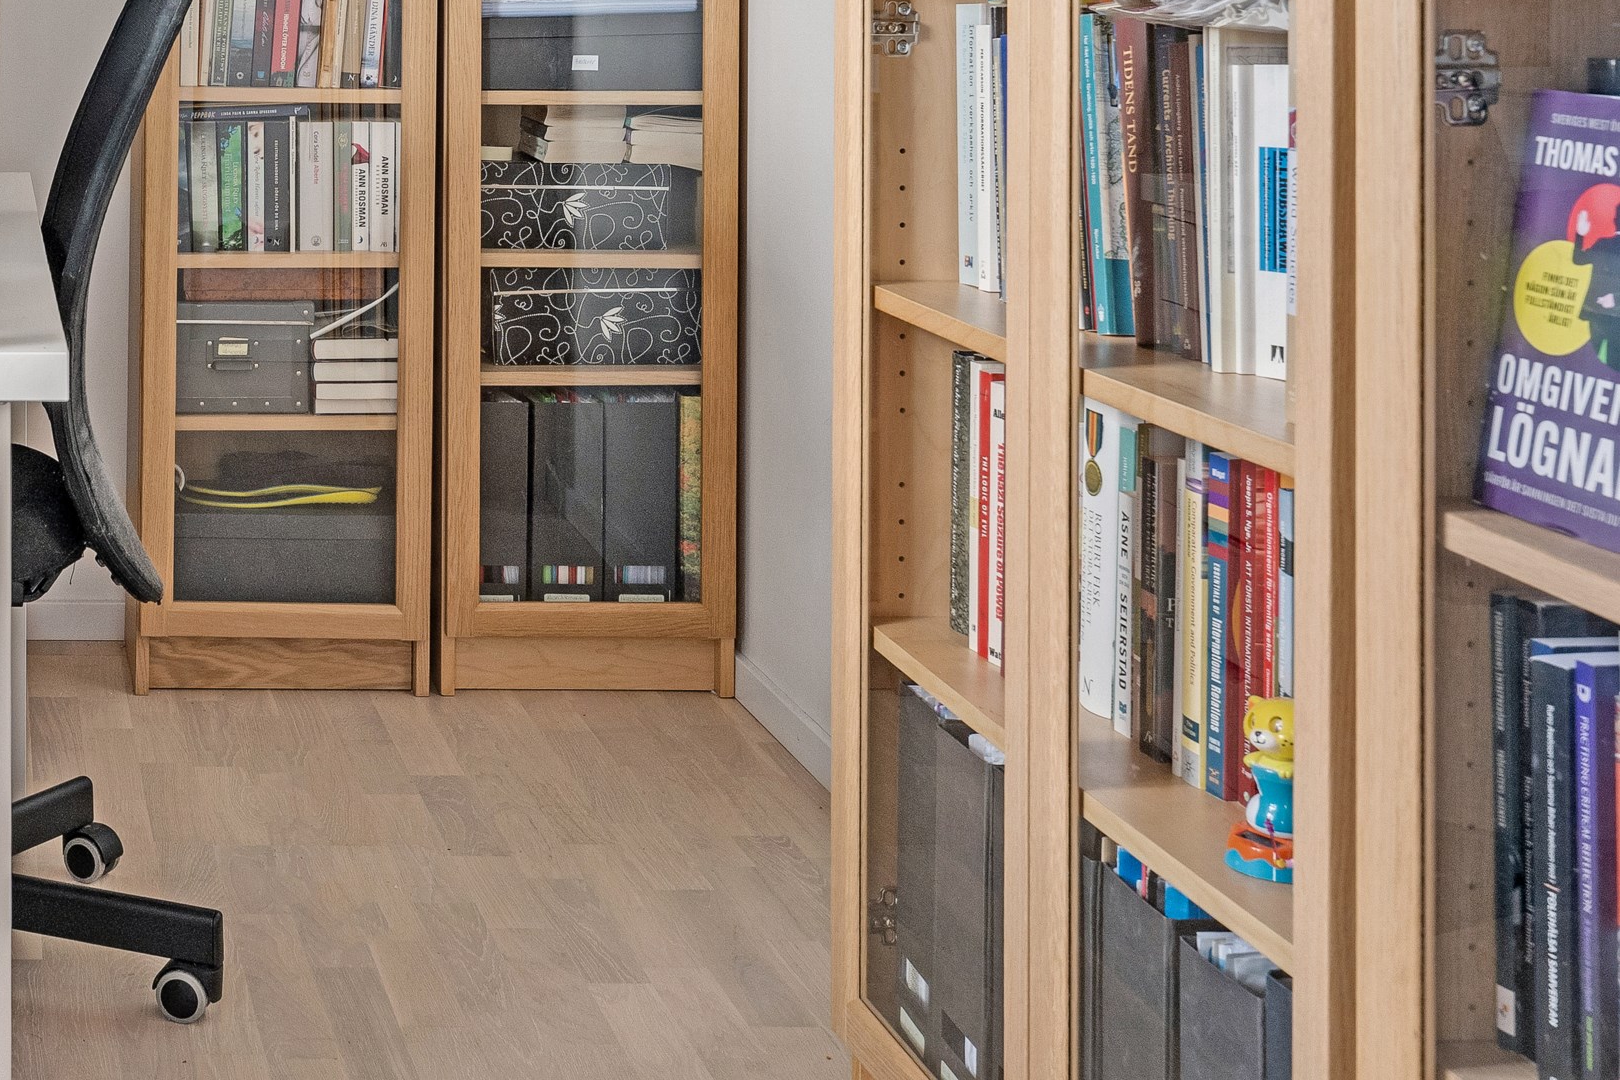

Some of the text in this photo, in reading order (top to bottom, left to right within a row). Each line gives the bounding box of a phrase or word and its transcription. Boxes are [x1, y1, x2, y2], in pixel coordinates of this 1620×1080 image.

[371, 0, 379, 21] DINA
[368, 23, 378, 57] HÄNDER
[1122, 46, 1138, 174] TIDENS TAND
[1161, 69, 1172, 121] Currents
[1163, 133, 1176, 186] Archival
[1534, 135, 1619, 177] THOMAS
[358, 168, 366, 228] ANN ROSMAN
[381, 156, 389, 215] ANN ROSMAN
[1165, 188, 1179, 241] Thinking
[1486, 401, 1620, 502] LÖGNA
[980, 455, 989, 537] THE LOGIC OF EVIL
[1243, 474, 1253, 508] Joseph
[1244, 508, 1253, 518] S.
[995, 504, 1005, 559] Seizure
[1242, 519, 1253, 542] Nye,
[1084, 543, 1094, 581] STORA
[1092, 512, 1103, 607] ROBERT FISK
[1244, 560, 1254, 577] ATT
[1263, 492, 1275, 662] Organisationsteori för offentlig sektor
[994, 571, 1005, 621] Power
[1084, 584, 1094, 628] KRIGET
[1118, 510, 1131, 690] ÅSNE SEIERSTAD
[1187, 500, 1198, 686] Comparative Government and Politics
[1243, 578, 1255, 614] FÖRSTÅ
[1209, 561, 1224, 733] ESSENTIALS OF International Relations
[1243, 615, 1254, 697] INTERNATIONELLA
[1580, 715, 1594, 915] PRACTISING CRITICAL REFLECTION
